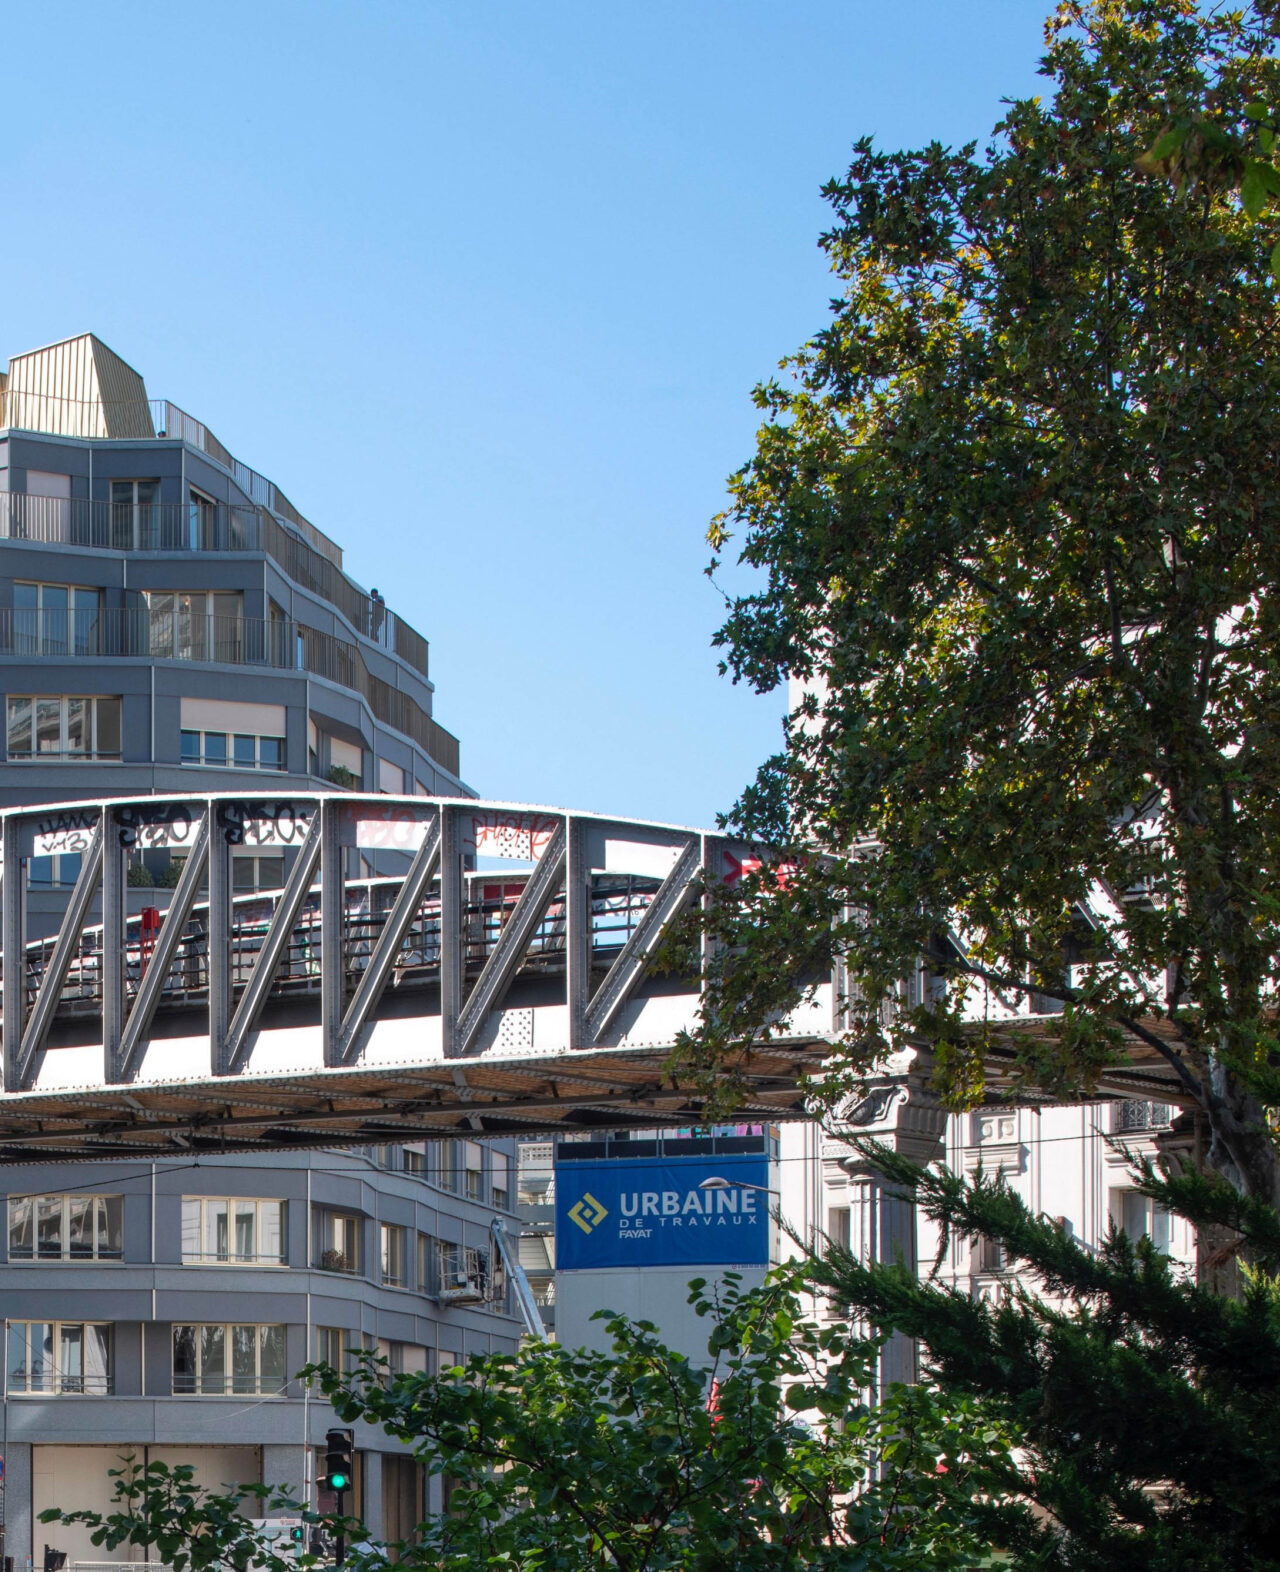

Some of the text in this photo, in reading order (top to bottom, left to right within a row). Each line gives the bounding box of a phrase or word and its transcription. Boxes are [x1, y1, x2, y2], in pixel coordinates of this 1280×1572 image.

[620, 1189, 756, 1217] URBAINE
[620, 1215, 757, 1228] DE TRAVAUX
[619, 1229, 653, 1239] FAYAT
